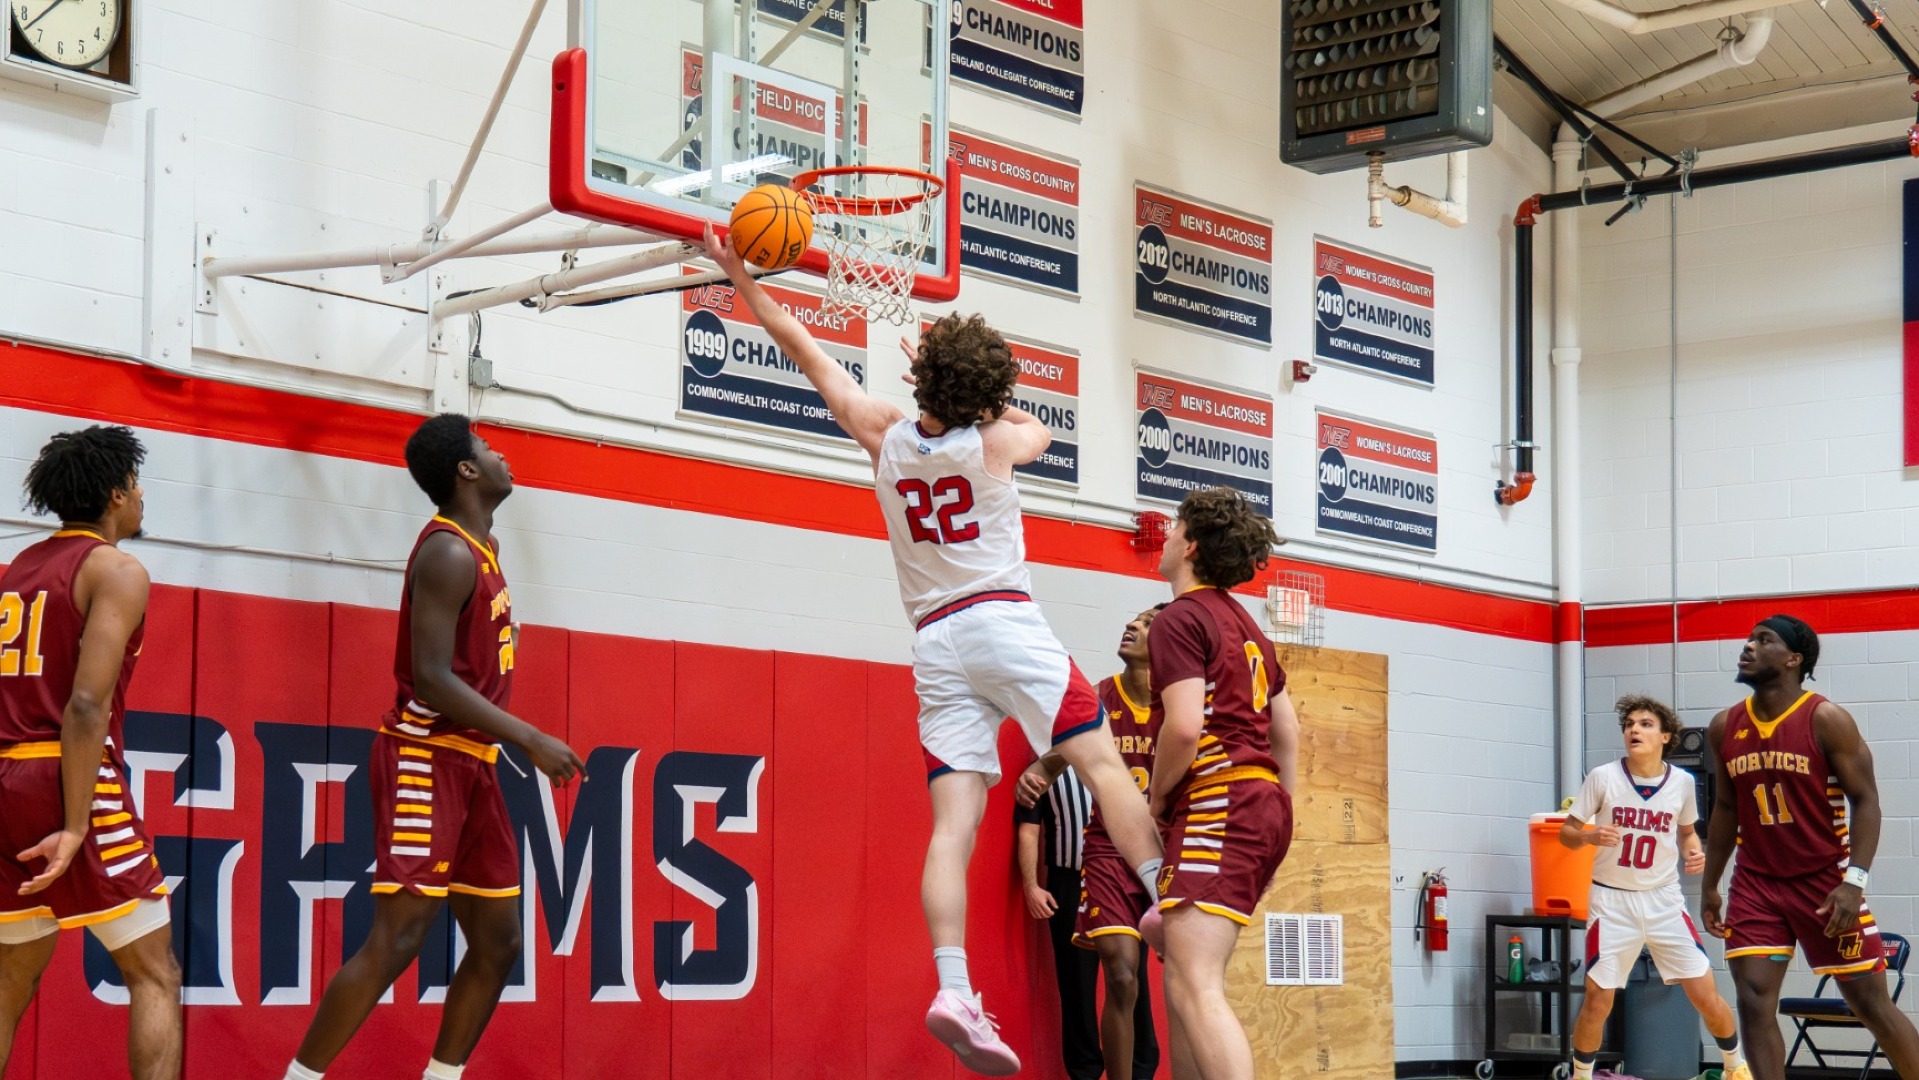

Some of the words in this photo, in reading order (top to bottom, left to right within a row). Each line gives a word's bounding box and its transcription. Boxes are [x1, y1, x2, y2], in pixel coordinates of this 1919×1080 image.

[21, 6, 28, 20] 8
[100, 2, 106, 17] 3
[37, 28, 43, 42] 7
[58, 40, 64, 54] 6
[78, 40, 84, 54] 5
[94, 26, 100, 40] 4
[966, 8, 1081, 62] CHAMPIONS
[951, 53, 984, 72] ENGLAND
[986, 64, 1028, 86] COLLEGIATE
[1029, 78, 1075, 100] CONFERENCE
[796, 98, 844, 126] HOCE
[968, 152, 998, 172] MEN'S
[1000, 162, 1031, 182] CROSS
[1032, 172, 1076, 194] COUNTRY
[962, 192, 1076, 240] CHAMPIONS
[1180, 214, 1212, 234] MEN'S
[1214, 222, 1266, 251] LACROSSE
[970, 242, 1008, 260] ATLANTIC
[1009, 252, 1060, 274] CONFERENCE
[1138, 239, 1168, 268] 2012
[1172, 250, 1269, 295] CHAMPIONS
[1346, 264, 1377, 282] WOMEN'S
[1378, 274, 1400, 288] CROSS
[1402, 282, 1432, 298] COUNTRY
[1153, 290, 1177, 305] NORTH
[1178, 297, 1210, 315] ATLANTIC
[1212, 306, 1257, 326] CONFERENCE
[1318, 290, 1343, 316] 2013
[1346, 298, 1432, 338] CHAMPIONS
[685, 328, 726, 360] 1999
[732, 338, 864, 385] CHAMS
[1017, 358, 1064, 382] HOCKEY
[1330, 336, 1351, 350] NORTH
[1352, 342, 1381, 358] ATLANTIC
[1382, 350, 1421, 368] CONFERENCE
[687, 383, 768, 408] COMMONWEALTH
[770, 398, 802, 415] COAST
[802, 405, 836, 421] CONFE
[1180, 394, 1212, 414] MEN'S
[1214, 402, 1267, 426] LACROSSE
[1139, 424, 1170, 452] 2000
[1173, 432, 1270, 470] CHAMPIONS
[1356, 436, 1391, 454] WOMEN'S
[1392, 445, 1432, 464] LACROSSE
[1141, 472, 1200, 492] COMMONWEALTH
[1320, 462, 1346, 488] 2001
[1348, 469, 1434, 504] CHAMPIONS
[895, 474, 980, 544] 22
[1321, 506, 1373, 526] COMMONWEALTH
[1374, 516, 1393, 529] COAST
[1394, 520, 1433, 538] CONFERENCE
[0, 590, 48, 676] 21
[1244, 640, 1269, 714] 0
[1726, 750, 1810, 778] NORWICH
[1612, 806, 1674, 833] GRIMS
[1752, 782, 1794, 826] 11
[82, 709, 767, 1006] GRMS
[1617, 832, 1657, 870] 10
